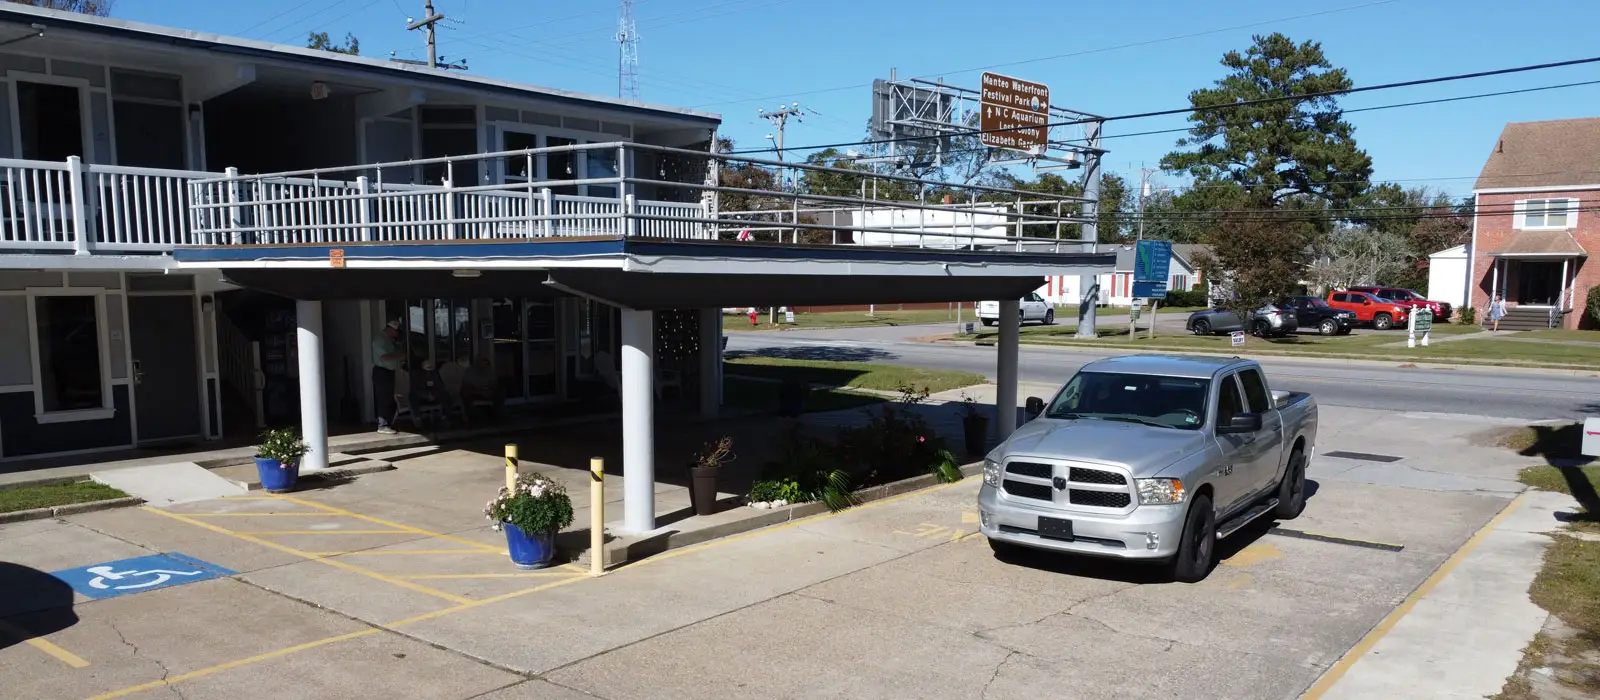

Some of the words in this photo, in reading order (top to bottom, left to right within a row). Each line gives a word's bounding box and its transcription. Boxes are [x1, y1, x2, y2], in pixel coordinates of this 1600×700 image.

[983, 75, 1009, 88] Manteo
[1012, 81, 1048, 97] Waterfront
[983, 89, 1012, 103] Festival
[1014, 95, 1031, 106] Park
[995, 108, 1001, 116] N
[1003, 110, 1009, 118] C
[1011, 111, 1045, 125] Aquarium
[982, 133, 1016, 146] Elizabeth
